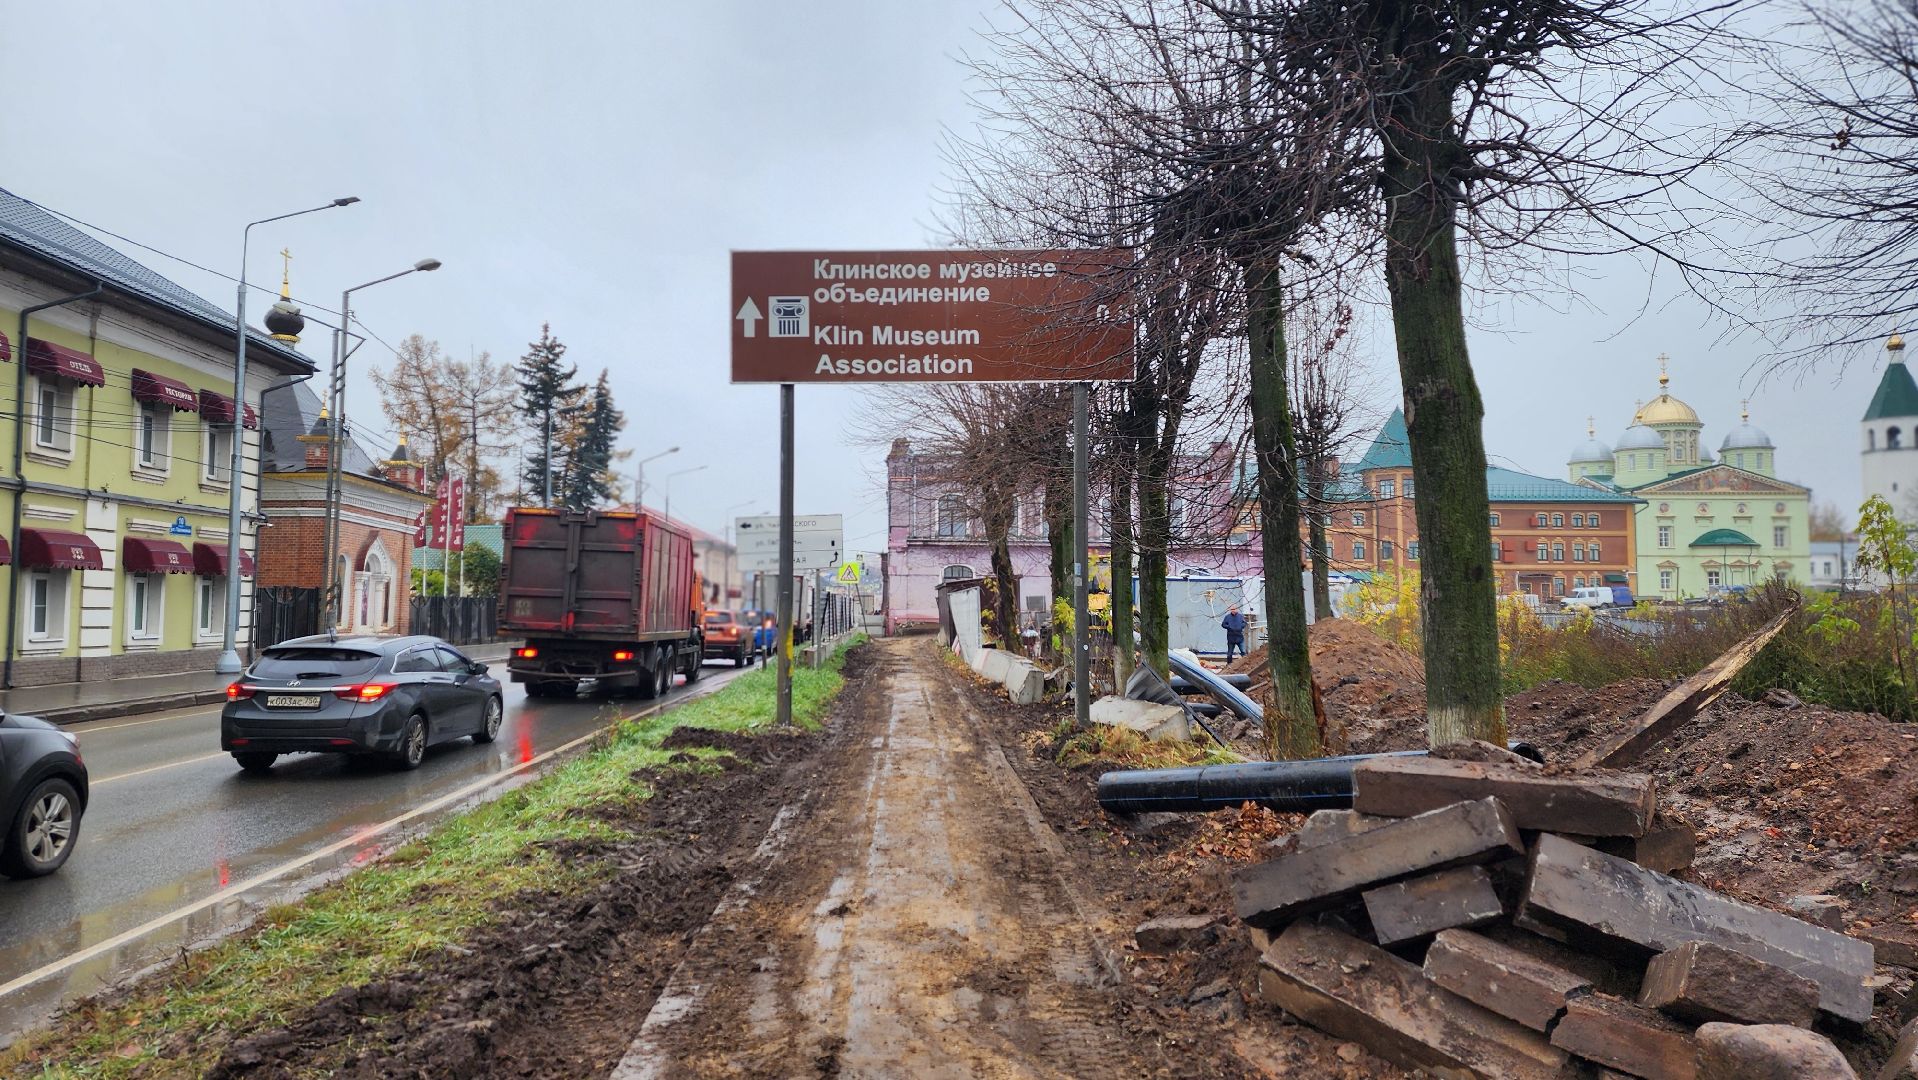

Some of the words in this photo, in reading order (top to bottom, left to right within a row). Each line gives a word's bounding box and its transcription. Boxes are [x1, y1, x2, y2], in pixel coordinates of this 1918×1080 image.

[813, 258, 931, 280] Клинское
[940, 257, 1058, 284] музейное
[813, 283, 990, 306] объединение
[814, 325, 864, 345] Klin
[872, 325, 980, 346] Museum
[815, 353, 973, 375] Association
